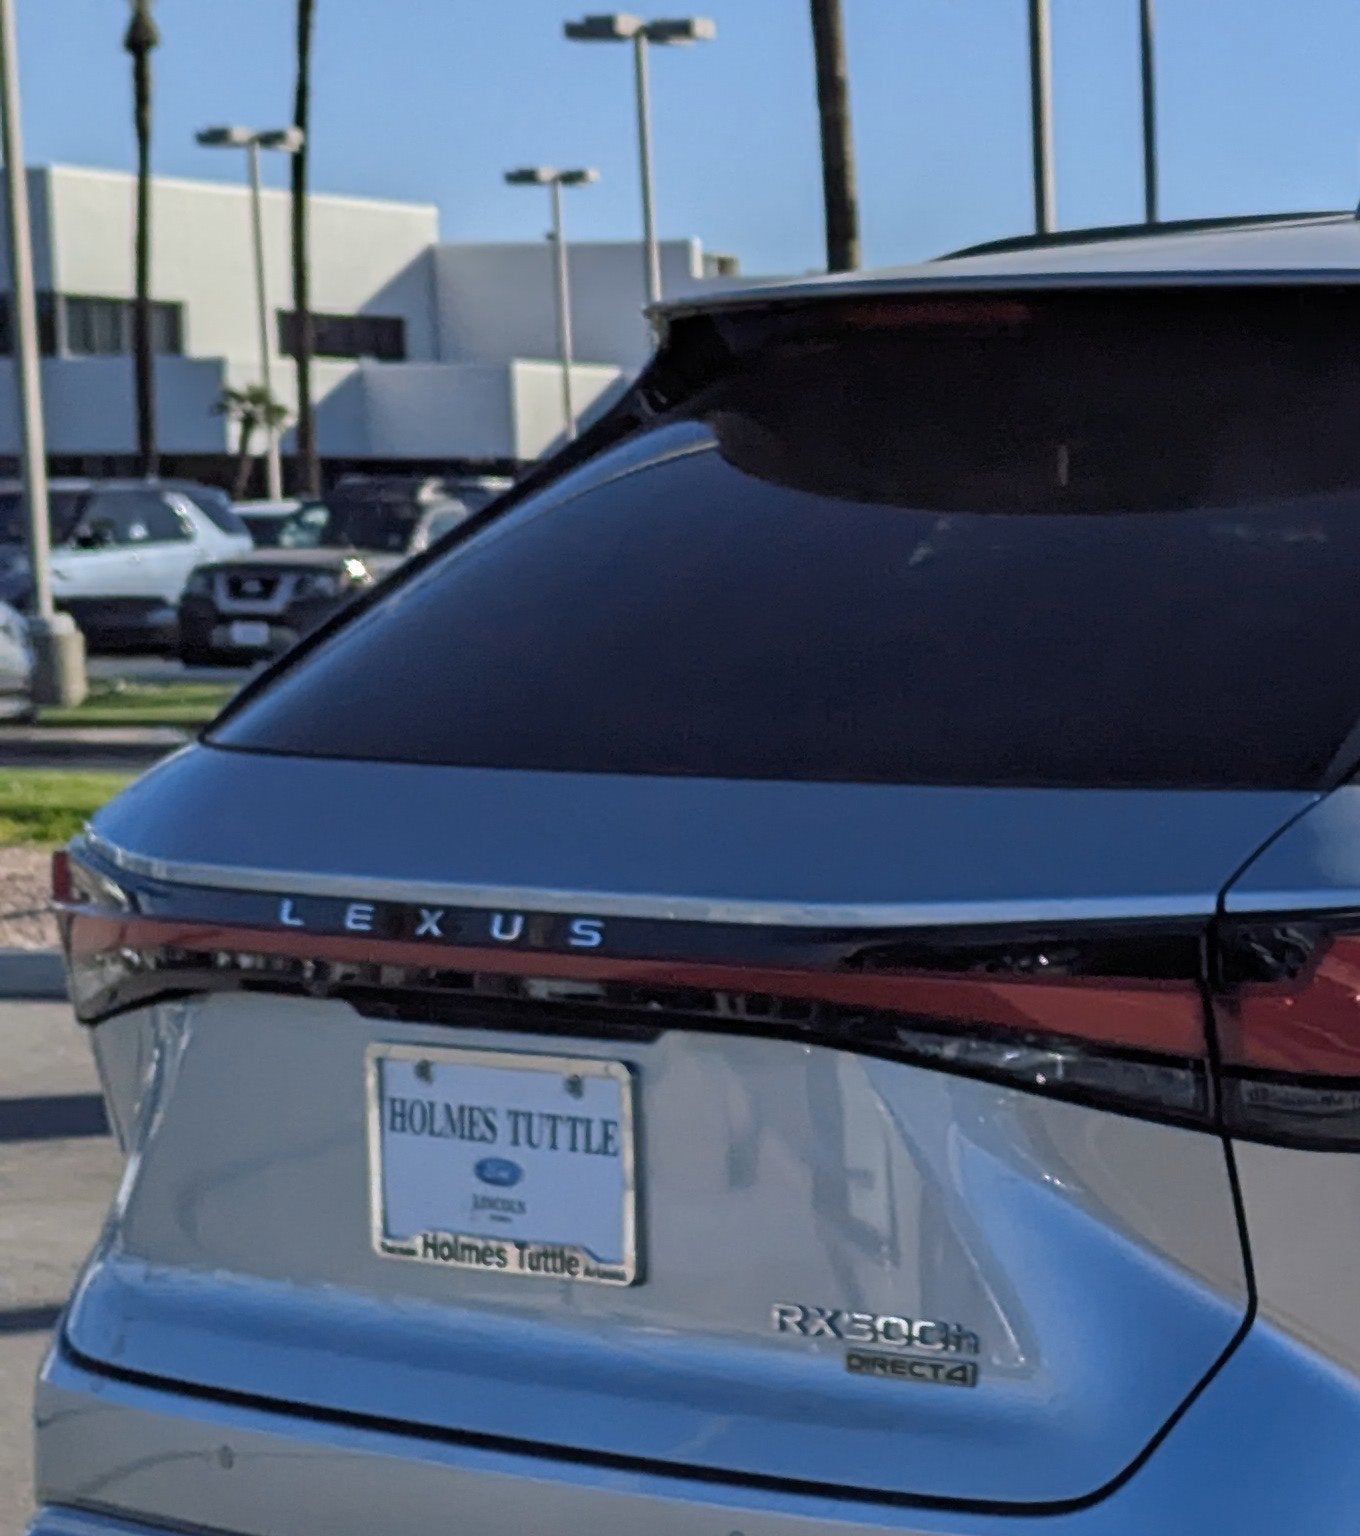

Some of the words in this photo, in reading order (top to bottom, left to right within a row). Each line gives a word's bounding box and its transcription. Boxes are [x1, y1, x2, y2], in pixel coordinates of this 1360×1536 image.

[279, 898, 606, 948] LEXUS
[389, 1097, 497, 1144] HOLMES
[506, 1109, 619, 1156] TUTTLE
[423, 1234, 507, 1269] Holmes
[514, 1243, 581, 1277] Tuttle
